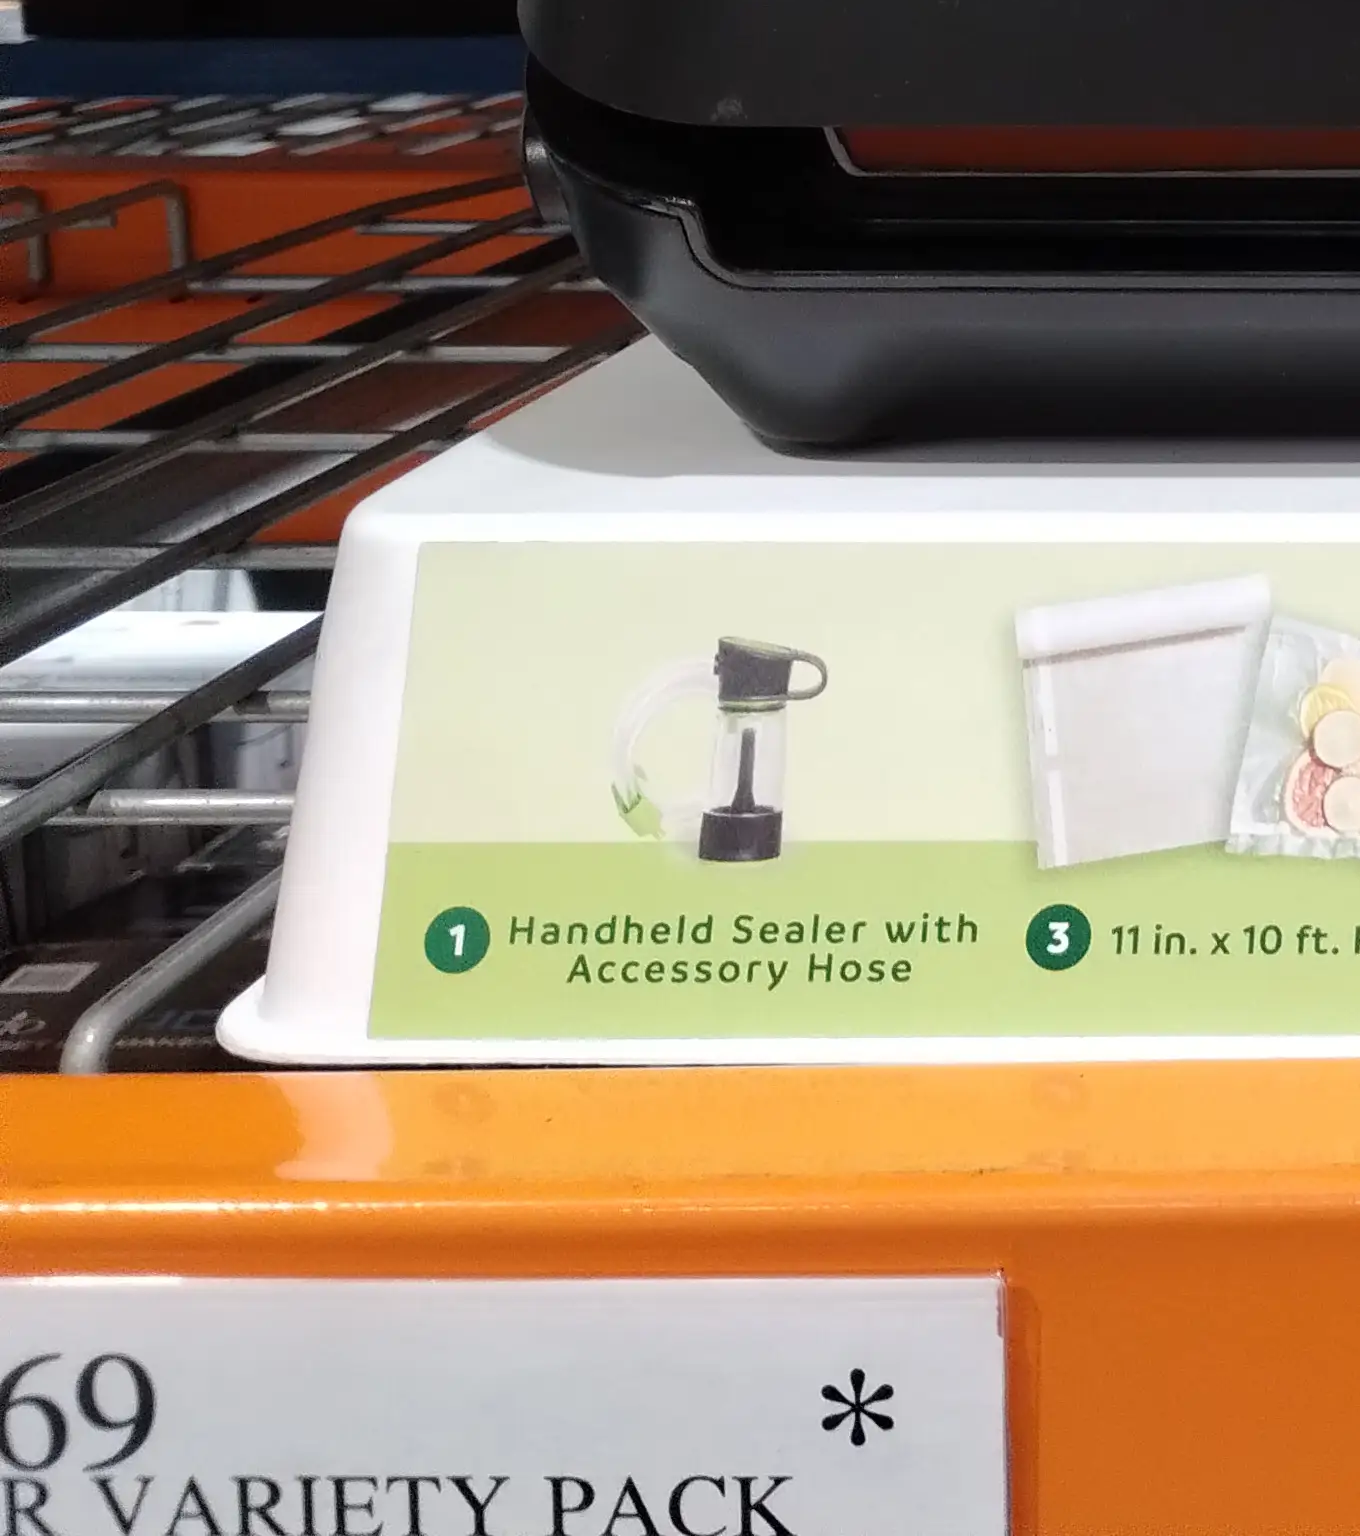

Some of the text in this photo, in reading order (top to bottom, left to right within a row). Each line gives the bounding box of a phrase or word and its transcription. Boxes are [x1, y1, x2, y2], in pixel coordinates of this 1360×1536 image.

[446, 913, 980, 957] 1 Handheld Sealer with
[1045, 921, 1072, 956] 3
[1110, 924, 1141, 956] 11
[1152, 923, 1198, 957] in.
[1209, 932, 1232, 956] x
[1242, 924, 1284, 956] 10
[1295, 923, 1341, 957] ft.
[565, 951, 914, 992] Accessory Hose
[0, 1351, 157, 1472] 69
[88, 1473, 511, 1536] VARIETY
[543, 1473, 800, 1536] PACK
